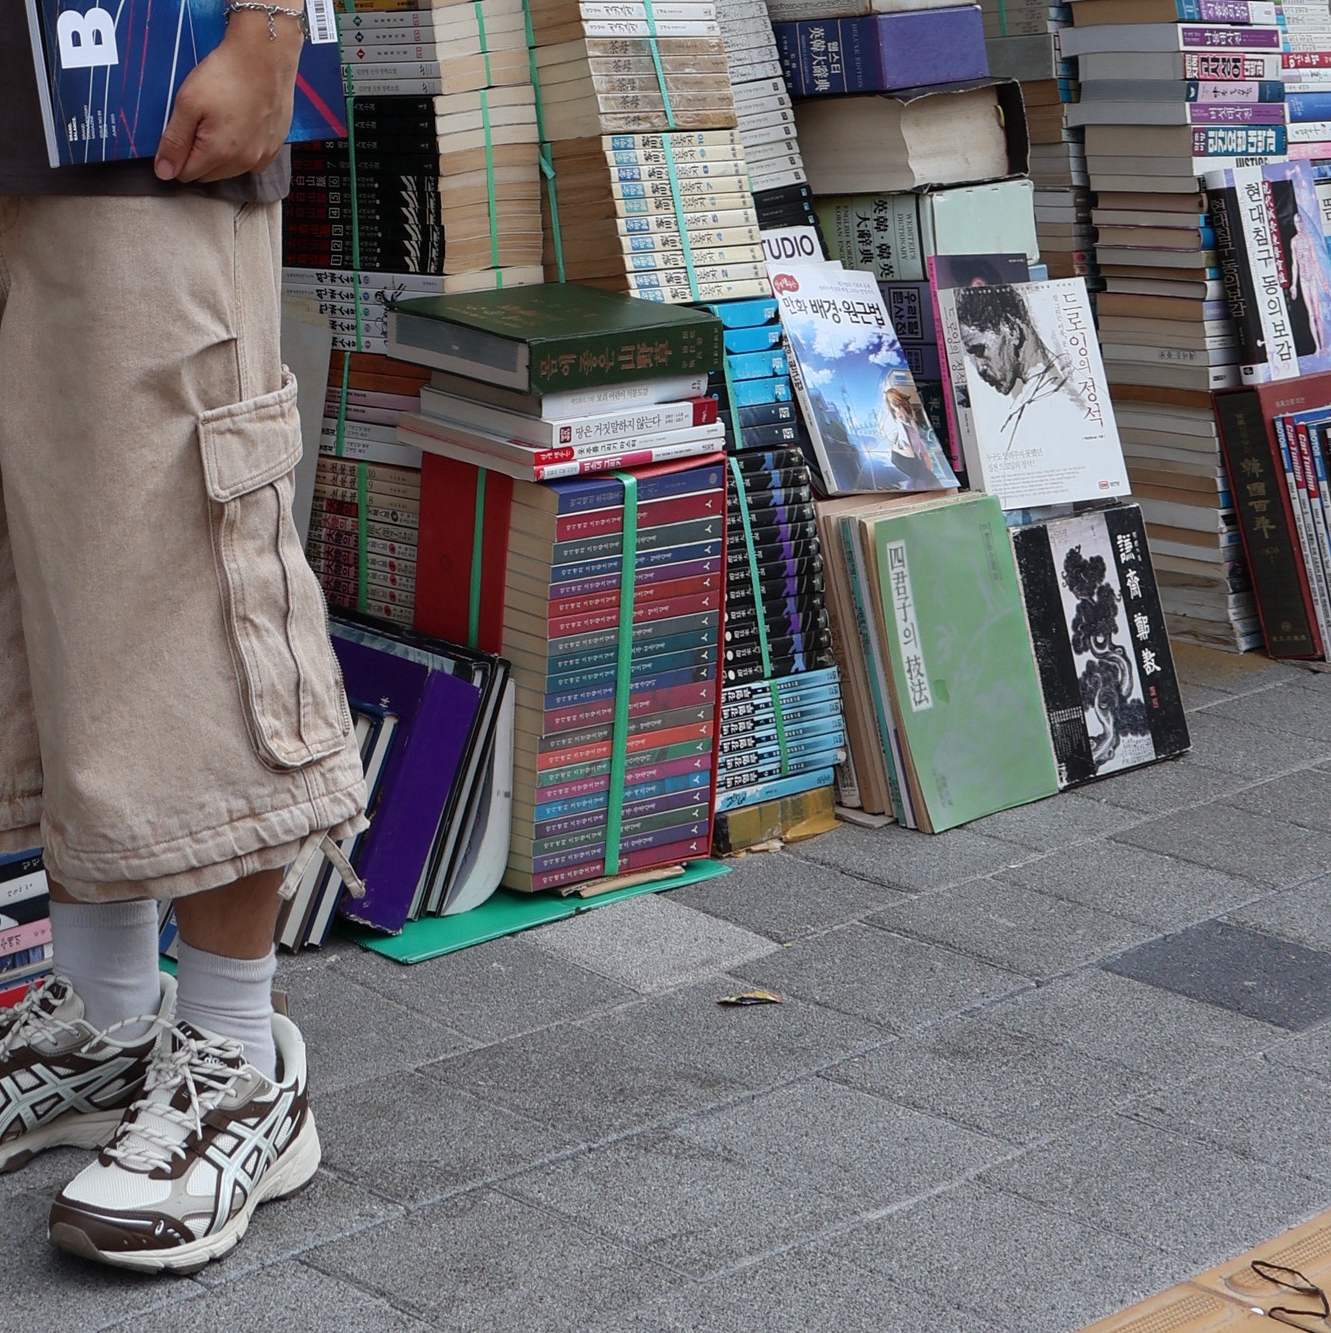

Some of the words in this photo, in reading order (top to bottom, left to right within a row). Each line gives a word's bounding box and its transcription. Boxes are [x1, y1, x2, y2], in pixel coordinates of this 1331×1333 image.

[56, 6, 119, 69] B
[784, 298, 807, 315] 만화
[1244, 182, 1274, 268] 현대침구
[1262, 275, 1293, 361] 동의보감
[1062, 293, 1092, 373] 드로잉의
[1078, 378, 1104, 427] 정석
[575, 426, 593, 440] 땅은
[594, 419, 634, 437] 거짓말하지
[635, 415, 661, 433] 않는다
[888, 545, 918, 649] 四君子의
[905, 655, 930, 707] 技法
